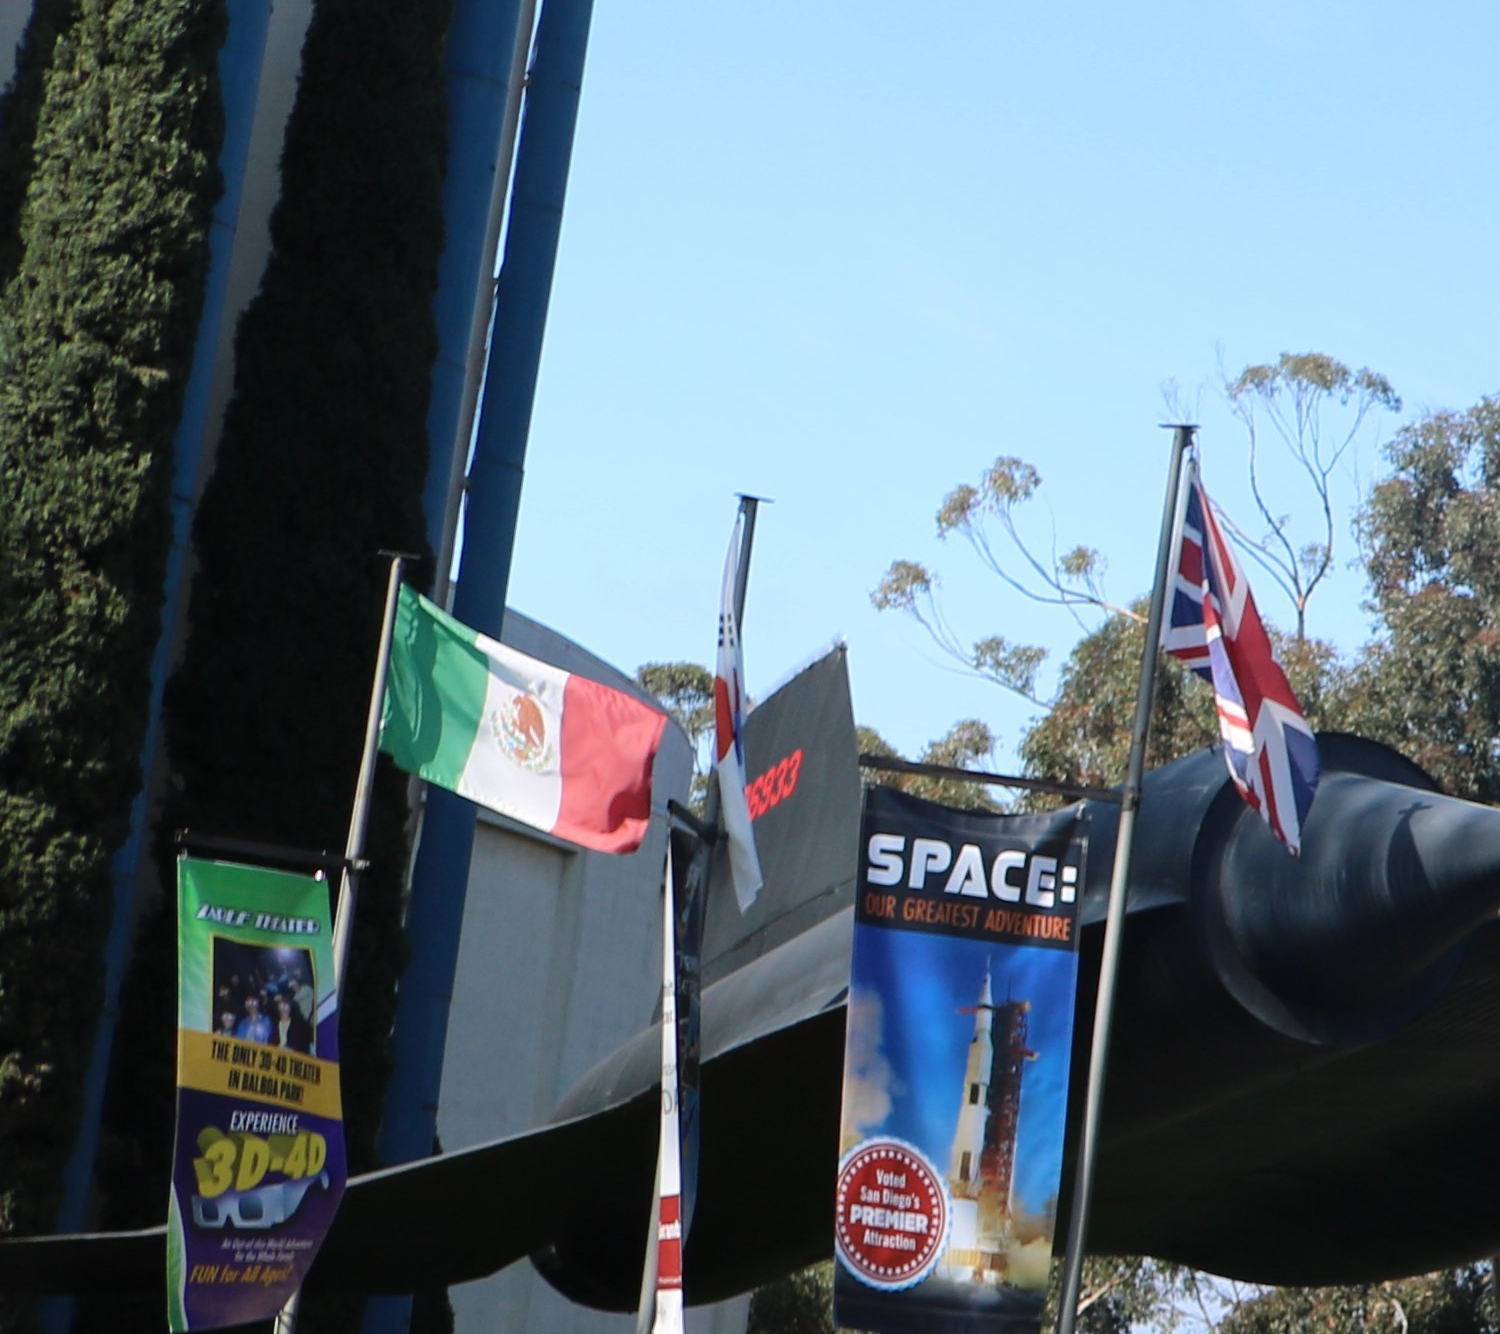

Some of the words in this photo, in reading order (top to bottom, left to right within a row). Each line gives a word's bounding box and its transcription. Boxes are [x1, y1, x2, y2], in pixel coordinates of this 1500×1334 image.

[866, 833, 1078, 909] SPACE:
[255, 913, 320, 934] THEATER
[866, 892, 896, 917] OUR
[903, 898, 980, 928] GREATEST
[984, 909, 1072, 941] ADVENTURE
[212, 1040, 229, 1061] THE
[232, 1045, 258, 1067] ONLY
[289, 1058, 321, 1084] THEATER
[228, 1069, 241, 1089] IN
[242, 1071, 278, 1097] BALBOA
[230, 1110, 299, 1134] EXPERIENCE
[193, 1132, 327, 1199] 3D-4D
[876, 1169, 906, 1190] Voted
[860, 1185, 880, 1203] San
[882, 1189, 920, 1210] Diego's
[850, 1204, 929, 1234] PREMIER
[863, 1228, 916, 1252] Attraction
[190, 1264, 219, 1283] FUN
[221, 1264, 239, 1283] for
[240, 1264, 261, 1283] All
